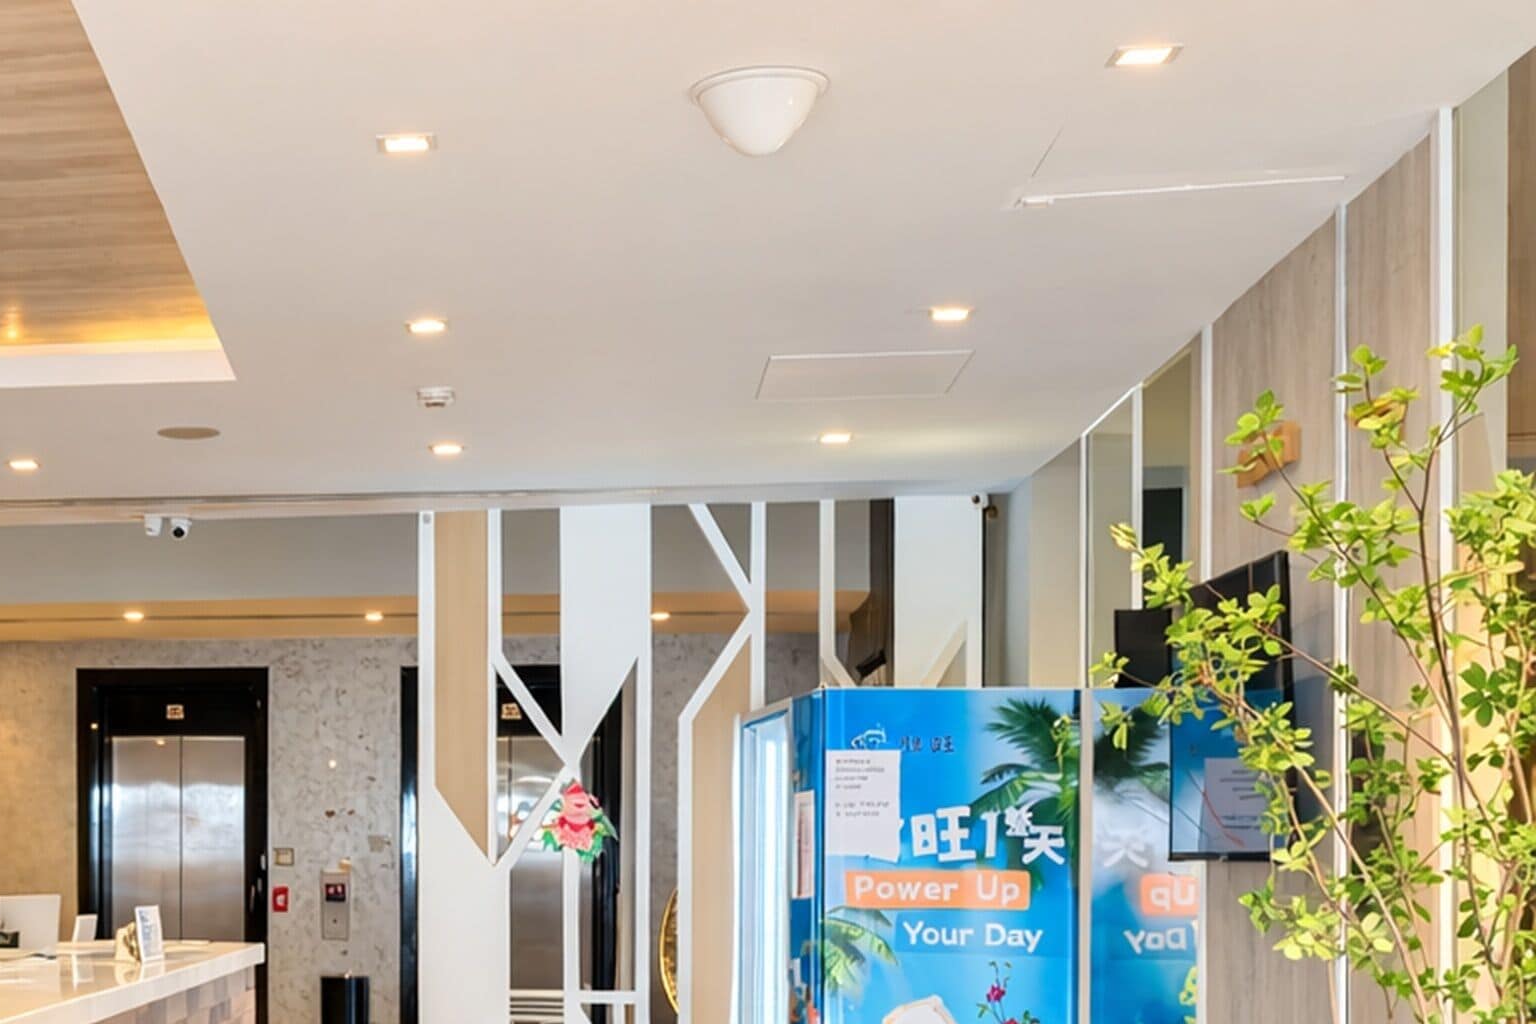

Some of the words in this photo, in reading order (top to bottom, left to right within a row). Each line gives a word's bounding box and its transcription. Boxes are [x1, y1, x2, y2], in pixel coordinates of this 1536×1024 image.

[854, 875, 960, 901] Power
[975, 873, 1021, 907] Up
[902, 920, 975, 946] Your
[984, 922, 1044, 954] Day
